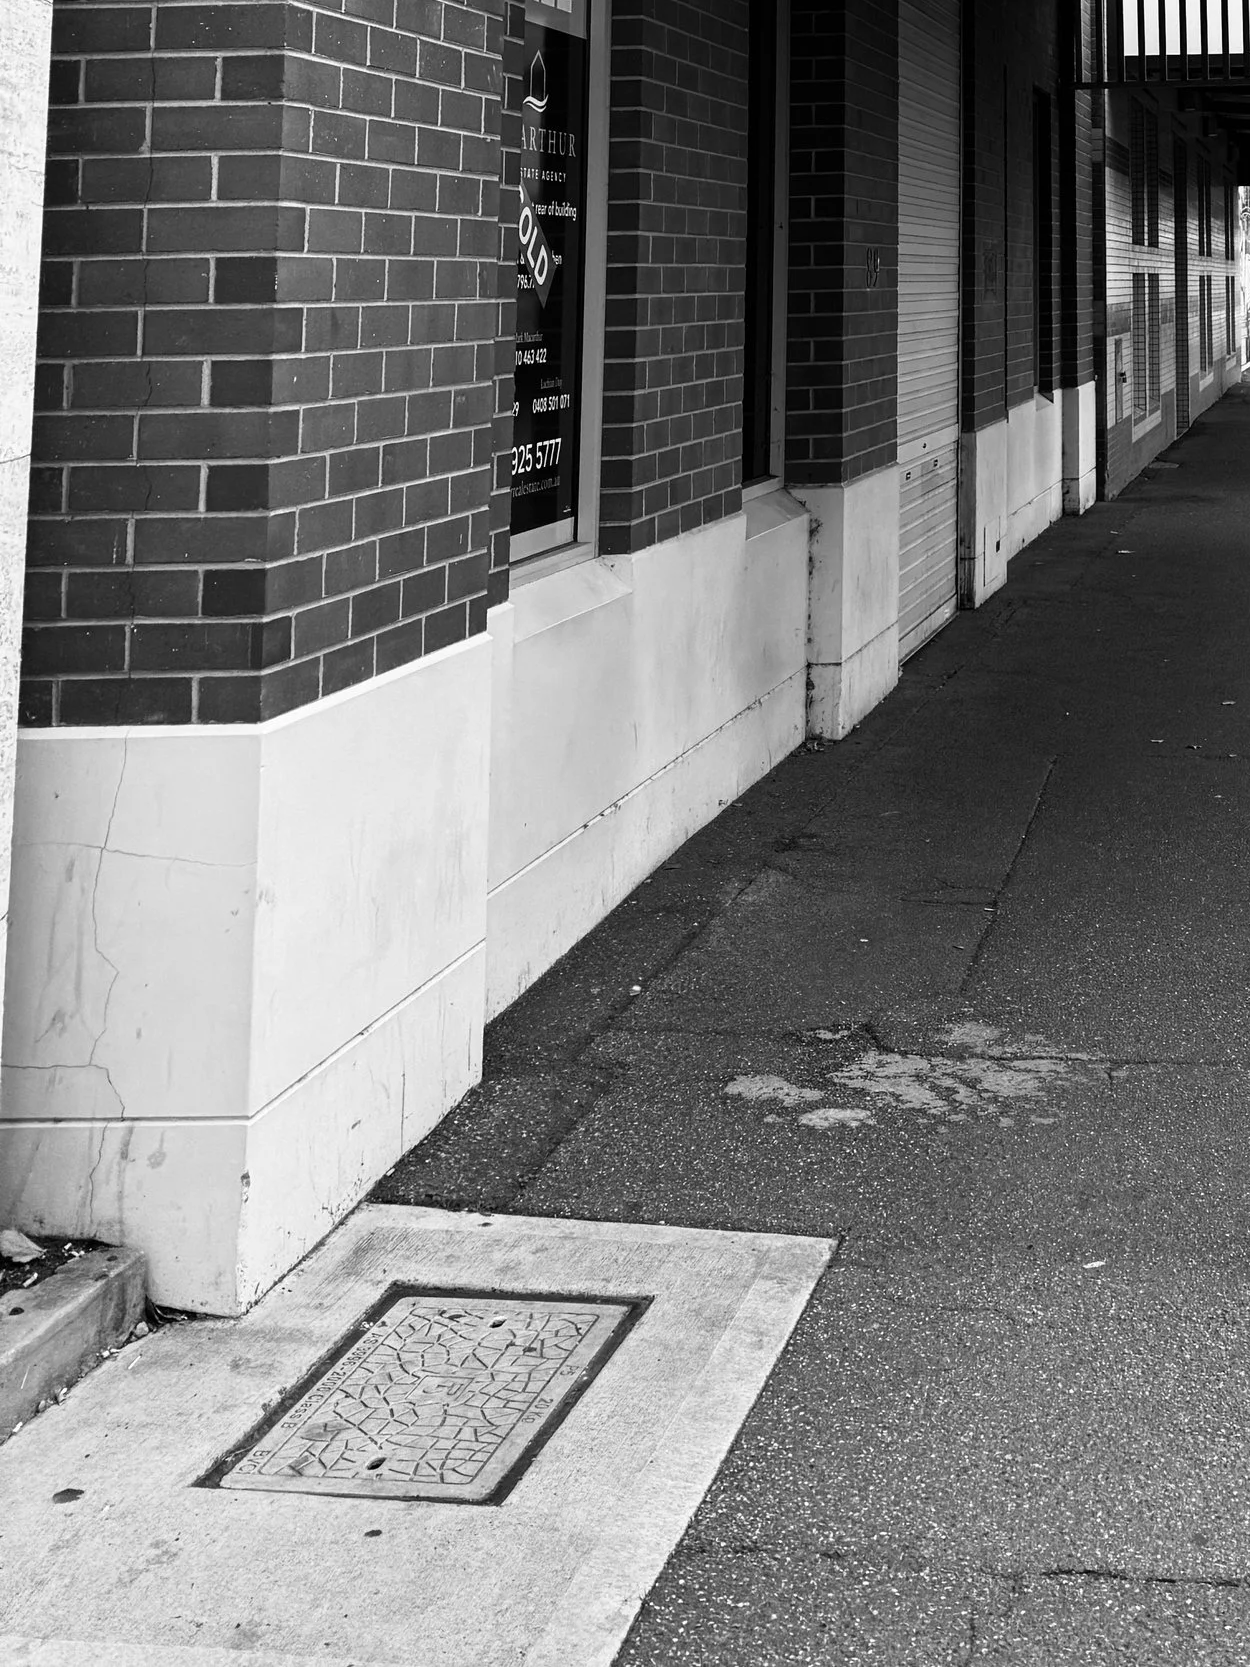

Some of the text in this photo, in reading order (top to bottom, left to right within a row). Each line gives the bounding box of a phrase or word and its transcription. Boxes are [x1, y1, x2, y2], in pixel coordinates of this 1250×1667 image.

[541, 170, 567, 183] AGENCY
[535, 204, 547, 215] rear
[555, 201, 577, 221] building
[866, 246, 880, 288] 89
[523, 349, 535, 365] 463
[535, 348, 547, 364] 422
[548, 396, 559, 412] 501
[560, 394, 570, 410] 071
[535, 437, 562, 469] 5777
[290, 1394, 324, 1419] Class
